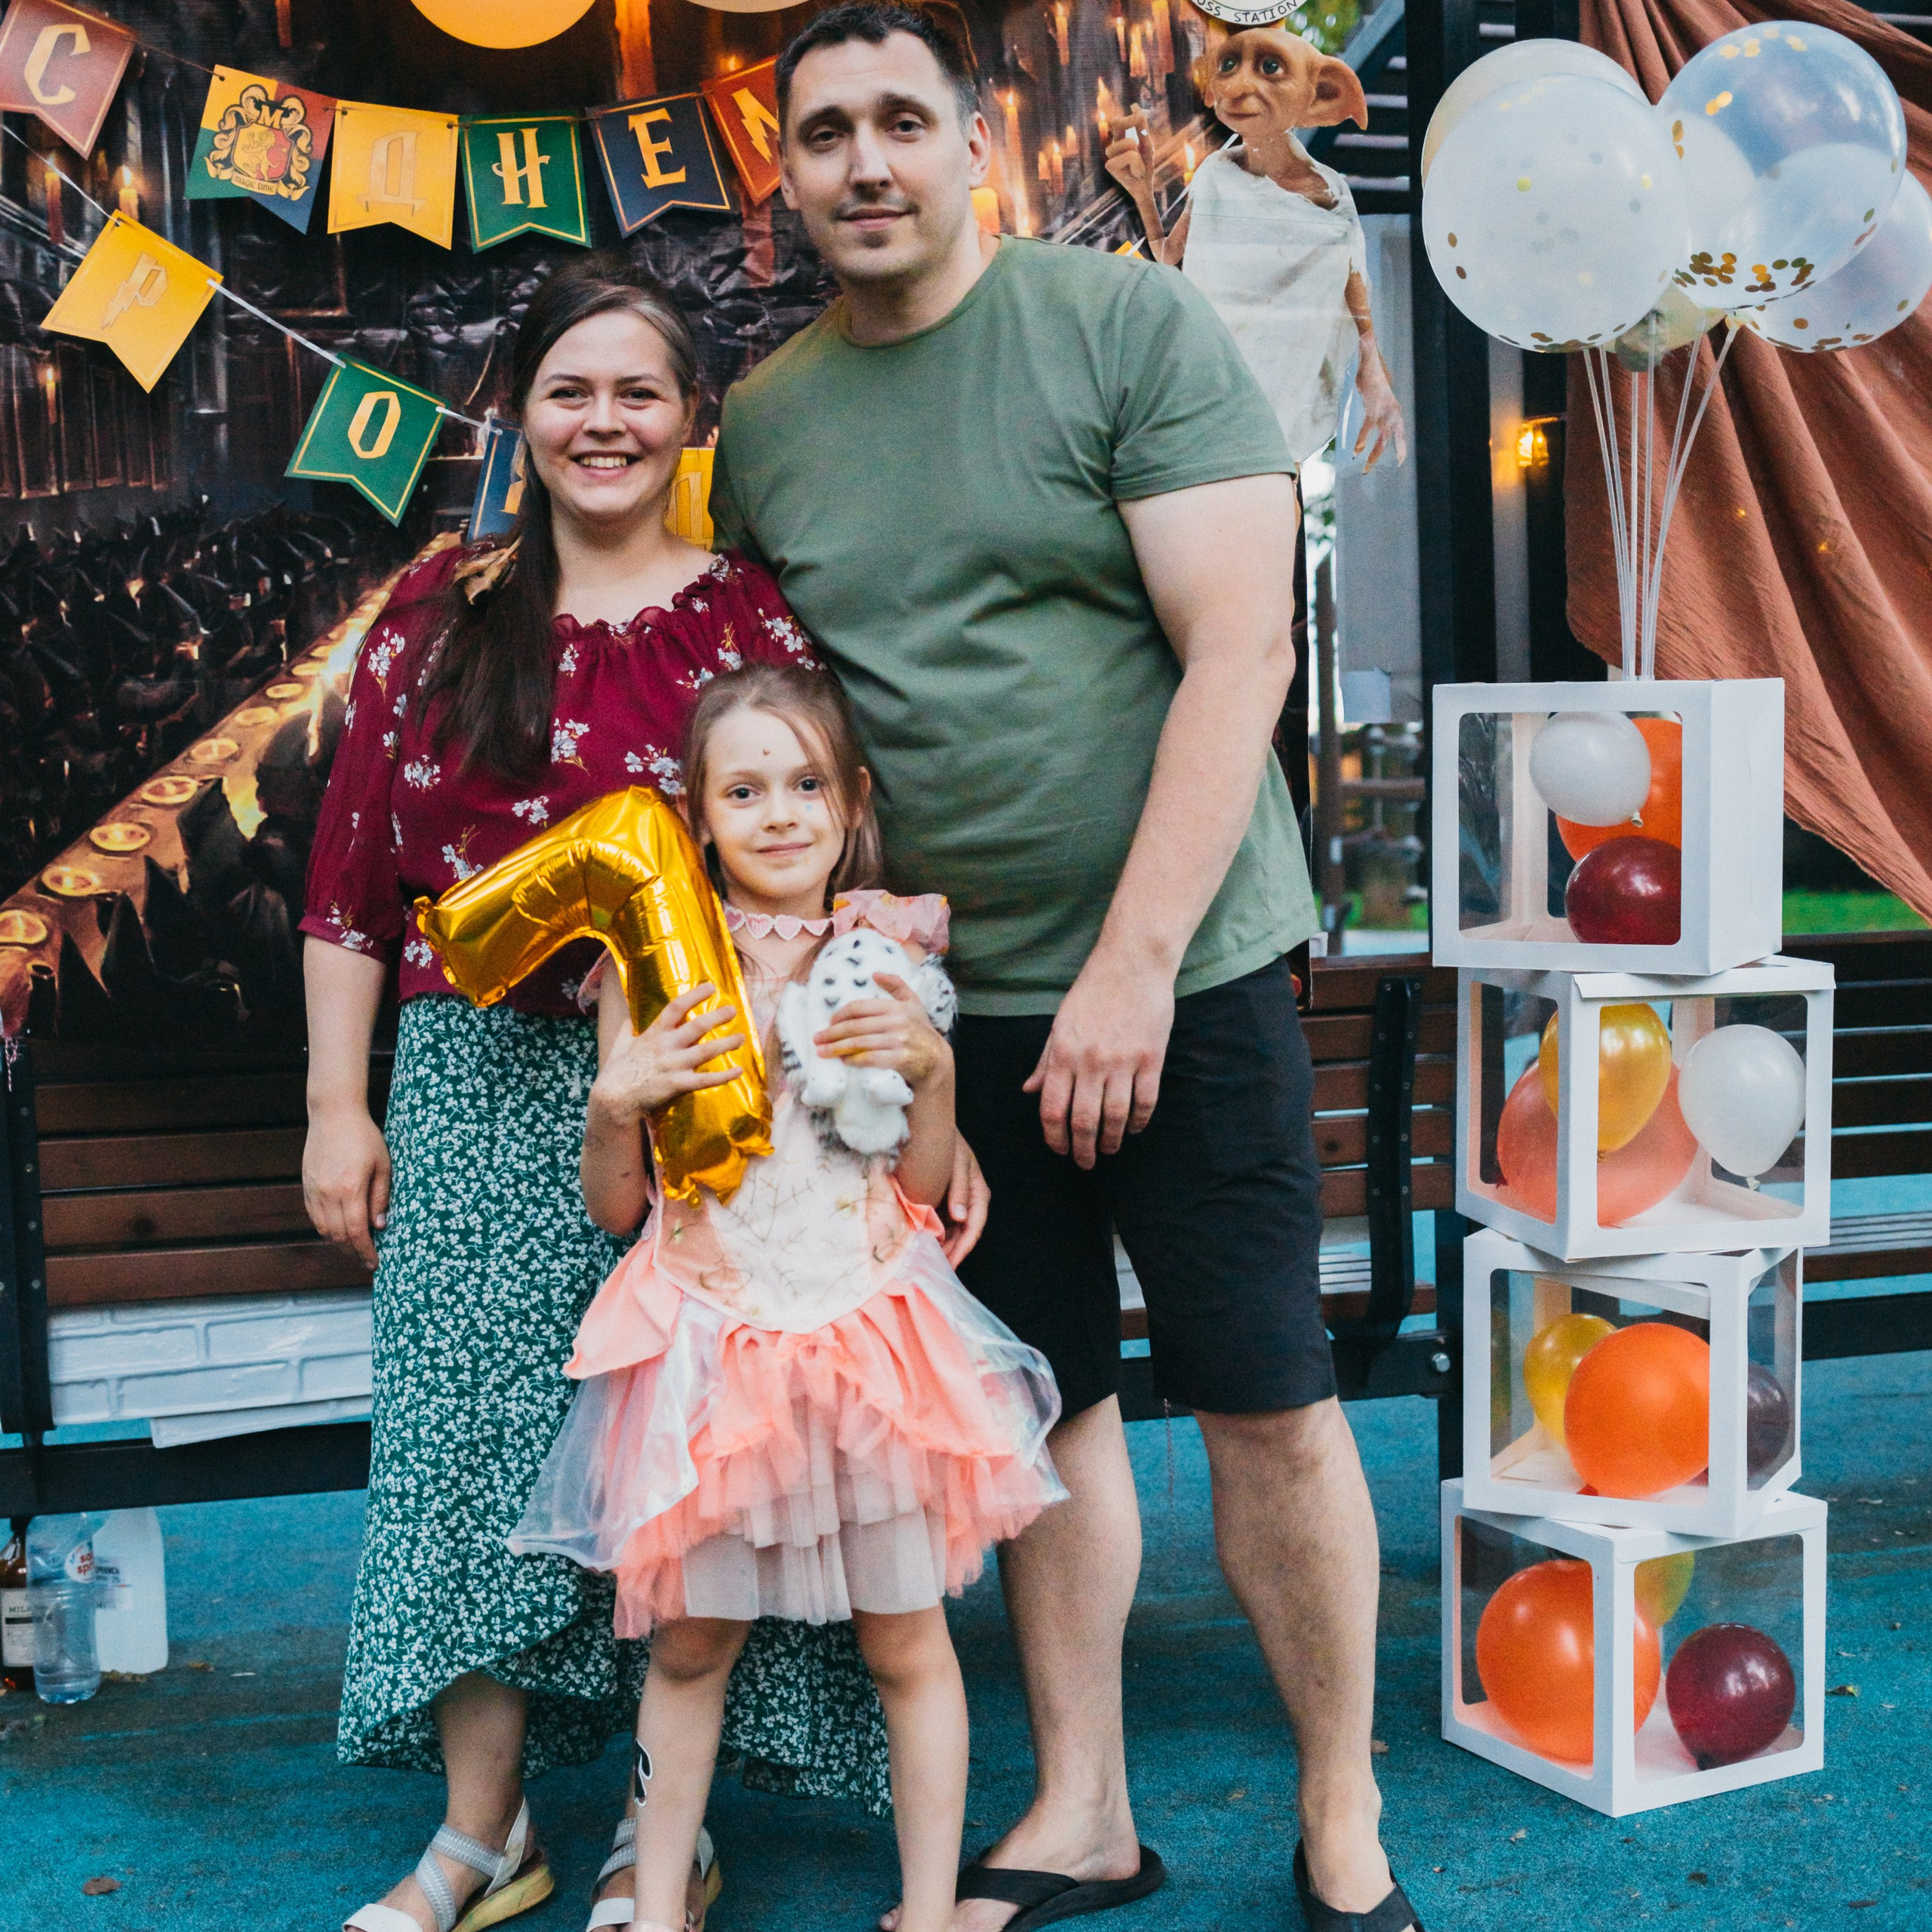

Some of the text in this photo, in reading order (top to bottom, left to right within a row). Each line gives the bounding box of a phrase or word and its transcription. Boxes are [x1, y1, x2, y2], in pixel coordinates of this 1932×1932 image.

[1234, 0, 1297, 23] STATION
[234, 175, 275, 192] magic time
[414, 785, 774, 1205] 7
